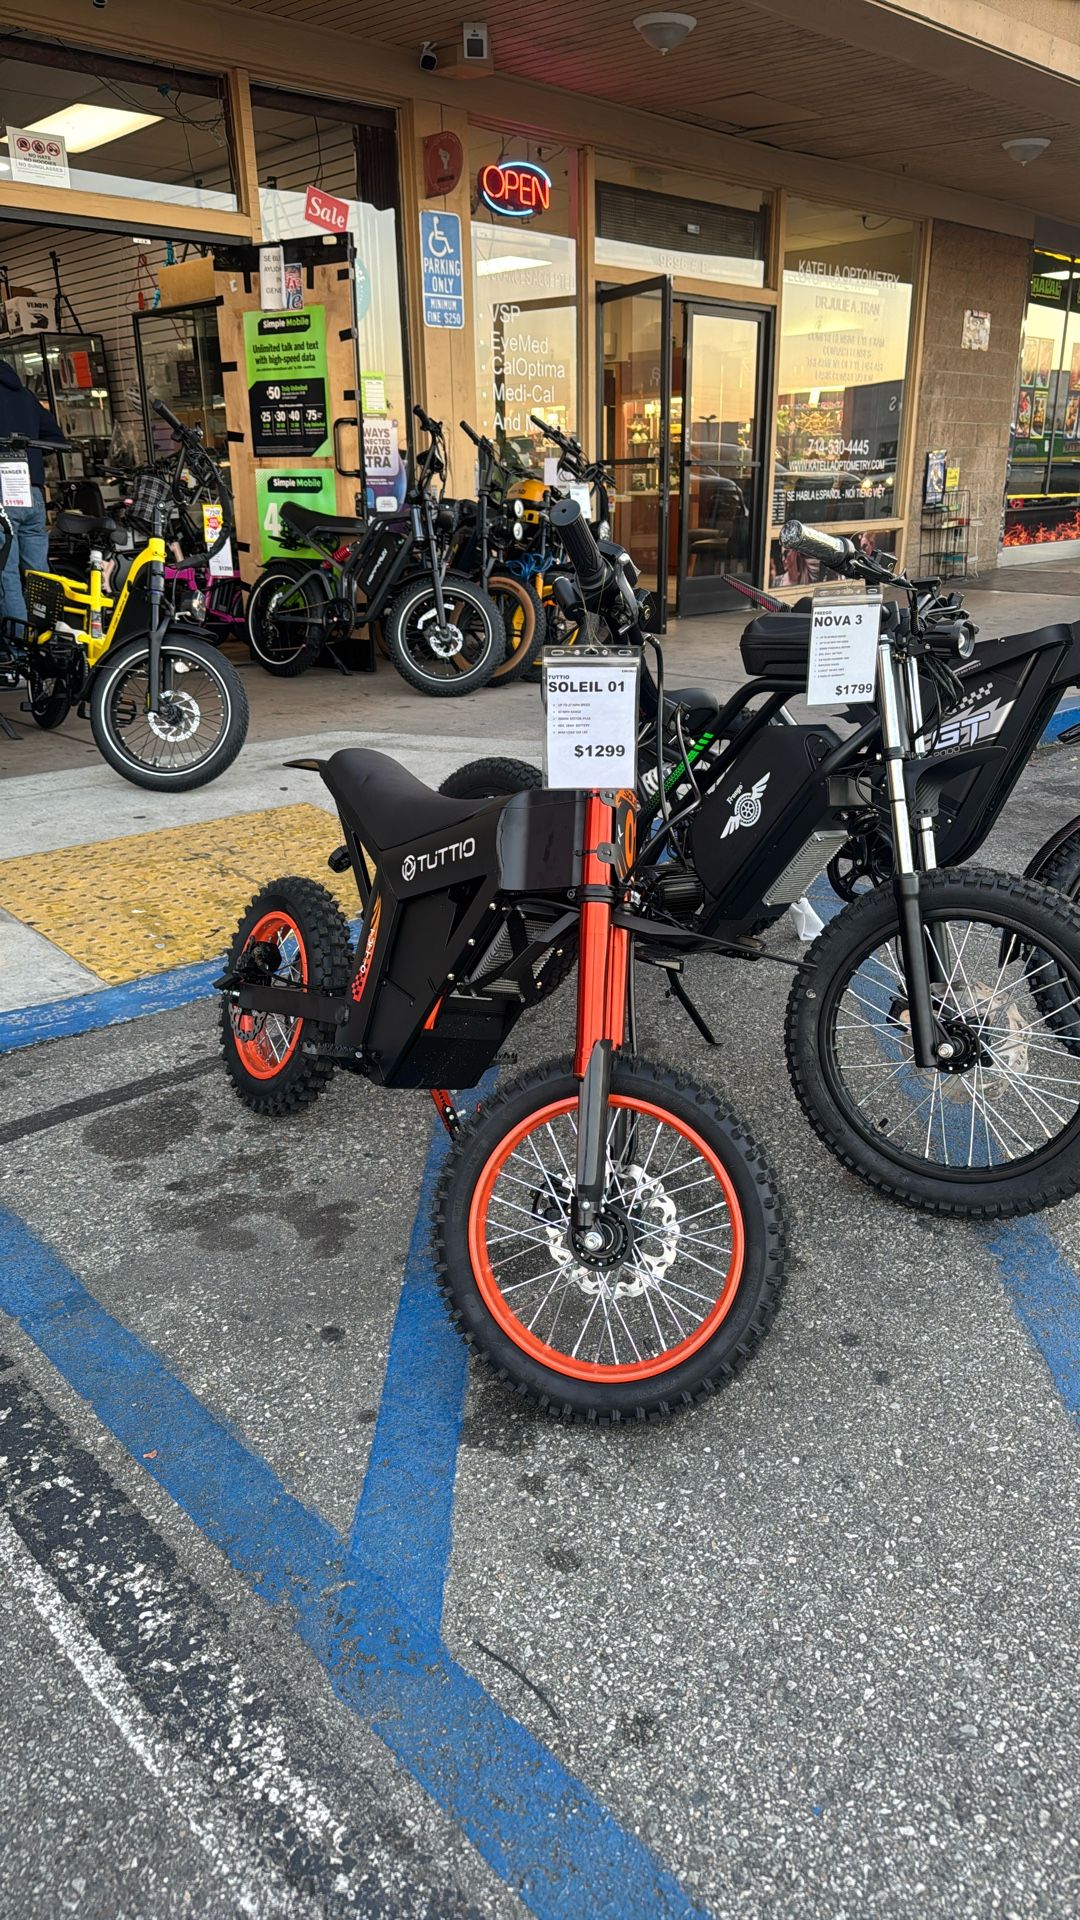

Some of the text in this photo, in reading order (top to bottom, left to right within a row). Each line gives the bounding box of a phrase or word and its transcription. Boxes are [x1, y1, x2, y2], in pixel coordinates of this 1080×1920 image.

[483, 164, 550, 210] OPEN
[308, 196, 345, 228] Sale
[424, 257, 461, 275] PARKING
[798, 259, 900, 289] KATELLA OPTOMETRY
[432, 276, 455, 293] ONLY
[1032, 278, 1061, 294] HALAL
[430, 298, 457, 311] MINIMUM
[428, 311, 461, 325] FINE $250
[488, 303, 521, 323] VSP
[263, 317, 309, 329] Simple Mobile
[252, 340, 319, 353] Unlimited talk and text
[490, 331, 548, 355] EyeMed
[255, 353, 316, 365] with high-speed data
[491, 356, 566, 379] CalOptima
[492, 382, 555, 403] Medi-Cal
[492, 412, 521, 431] And
[808, 439, 869, 456] 714-530-4445
[789, 459, 885, 471] WWW.KATELLAOPTOMETRY.COM
[273, 479, 321, 488] Simple Mobile
[787, 491, 795, 502] SE
[796, 489, 815, 501] HABLA
[815, 488, 841, 500] ESPAÑOL
[814, 615, 863, 627] NOVA 3
[548, 681, 625, 693] SOLEIL 01
[835, 683, 873, 696] $1799
[574, 744, 626, 758] $1299
[417, 837, 475, 872] TUTTIO
